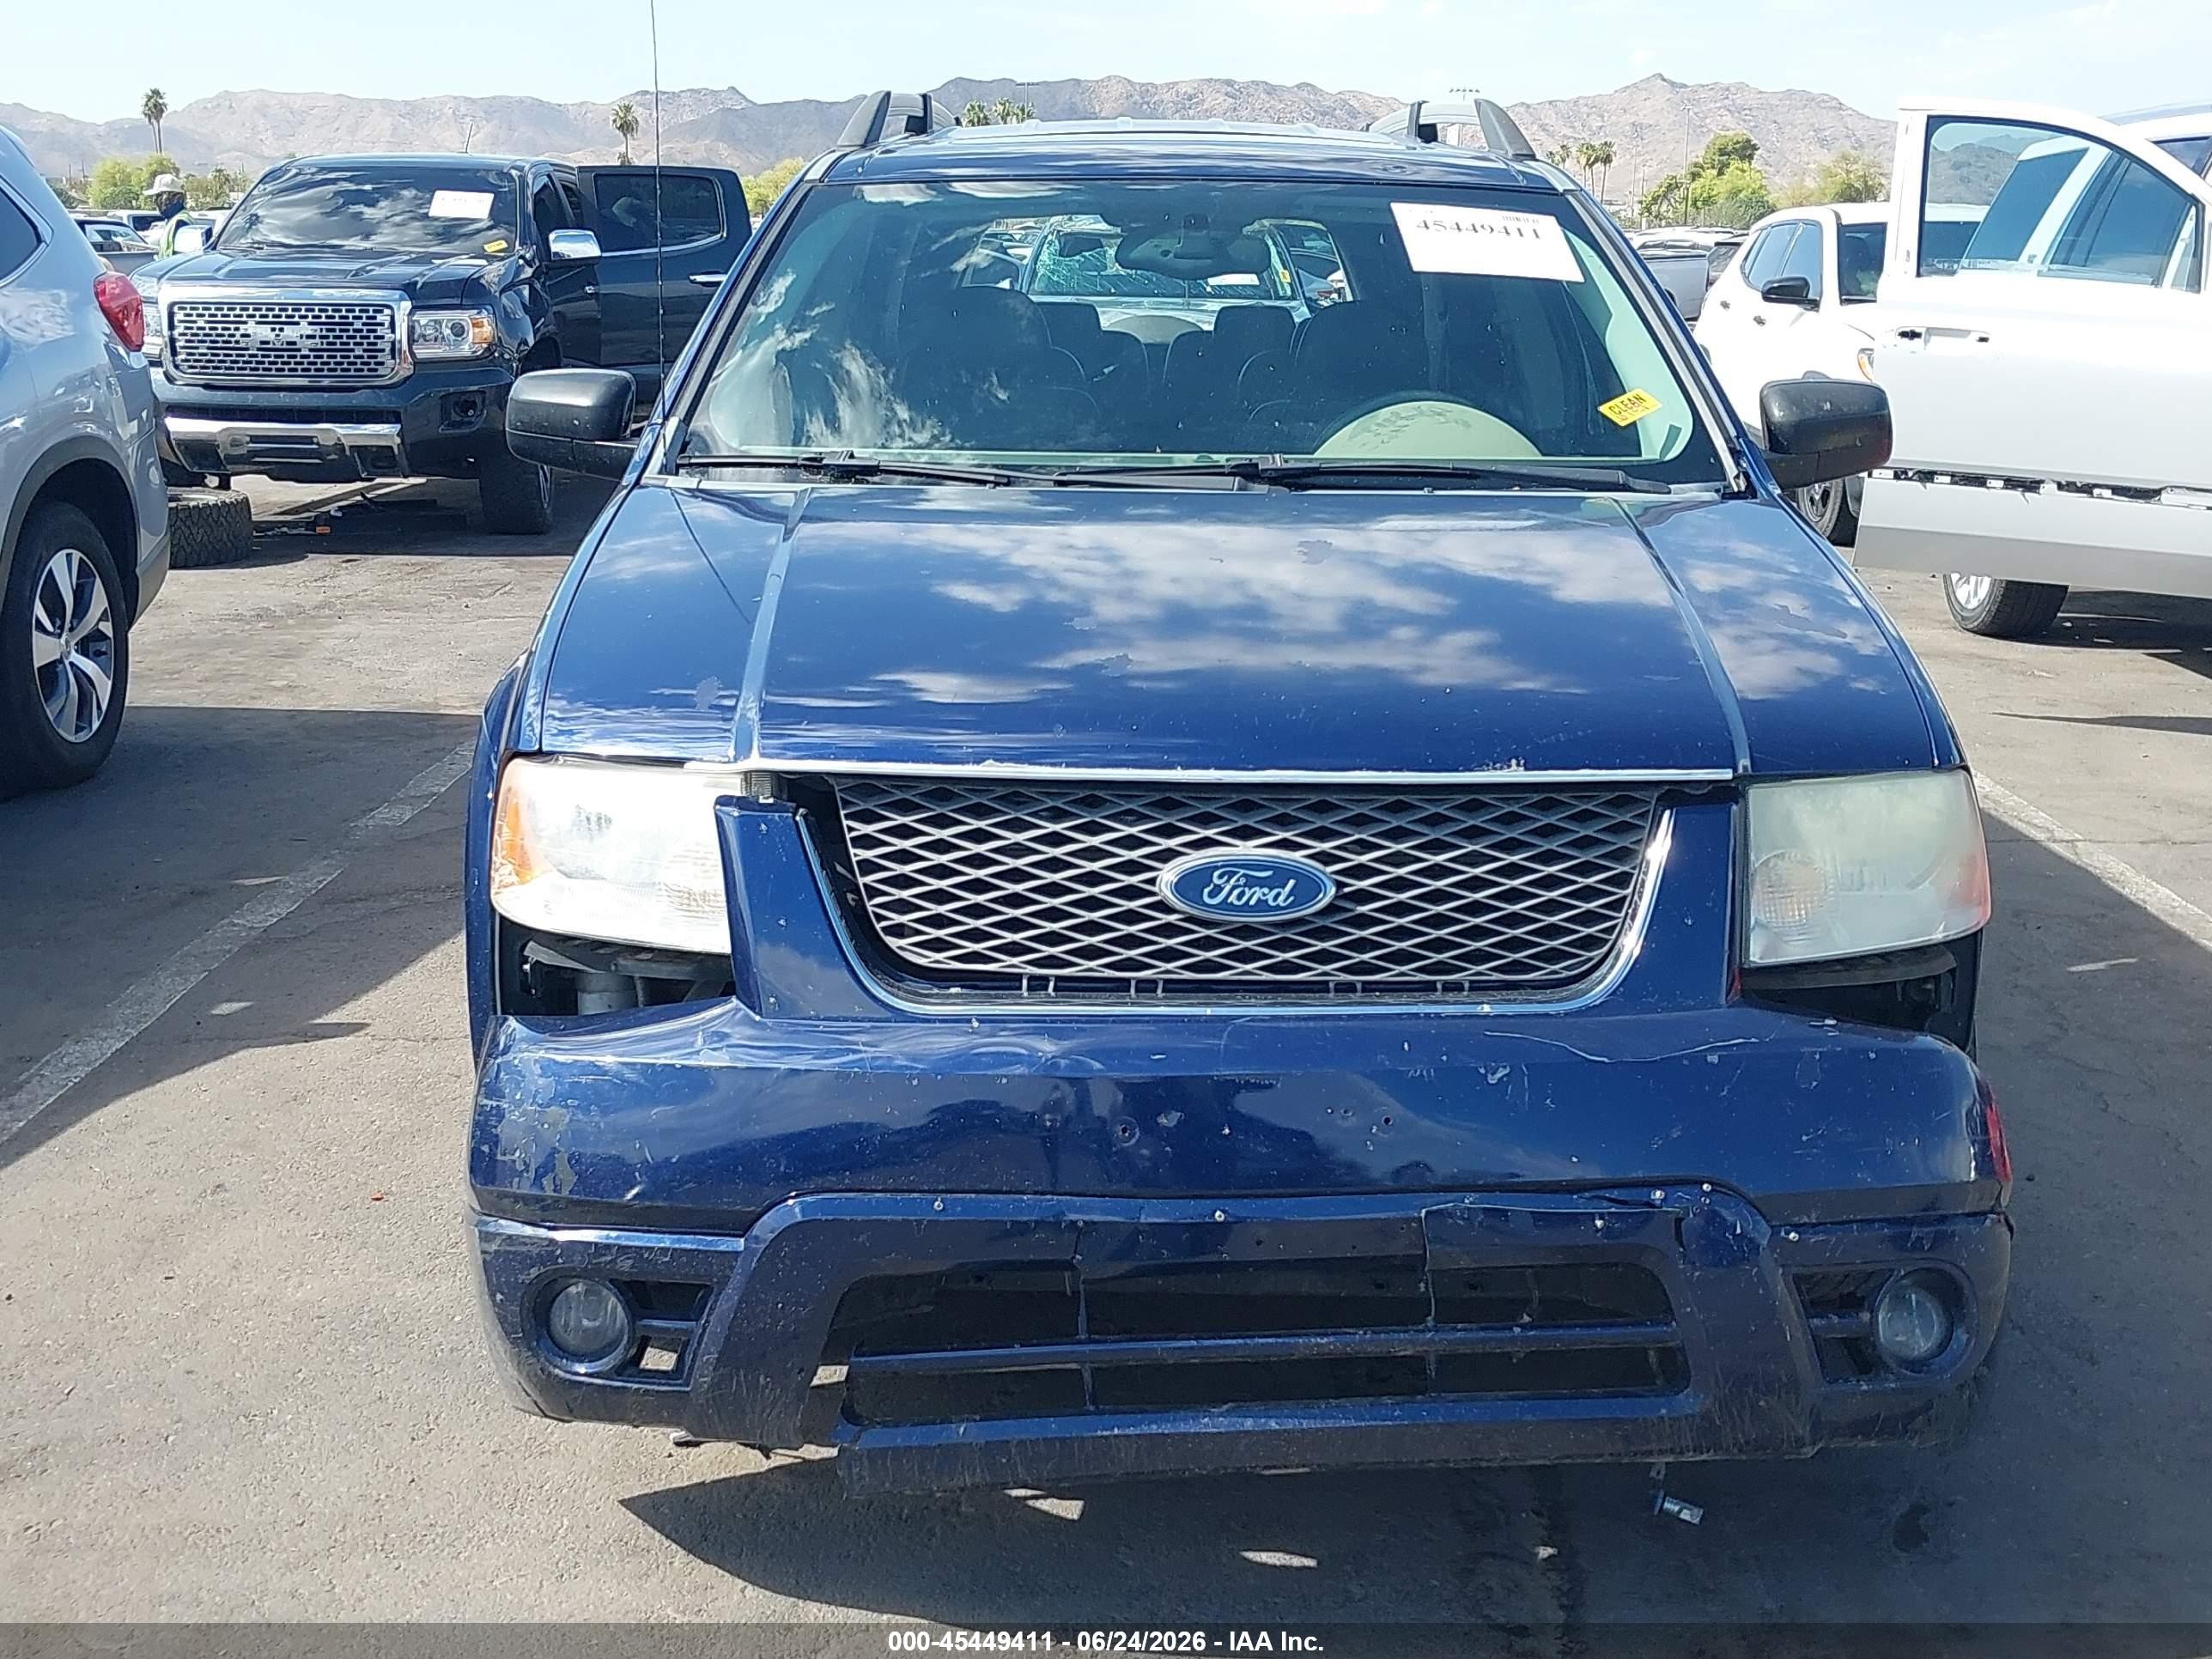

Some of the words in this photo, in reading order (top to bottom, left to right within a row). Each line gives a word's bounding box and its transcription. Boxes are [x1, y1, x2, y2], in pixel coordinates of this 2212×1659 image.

[1417, 219, 1540, 239] 45449411
[1608, 393, 1647, 416] CLEAN
[1203, 866, 1297, 907] Ford
